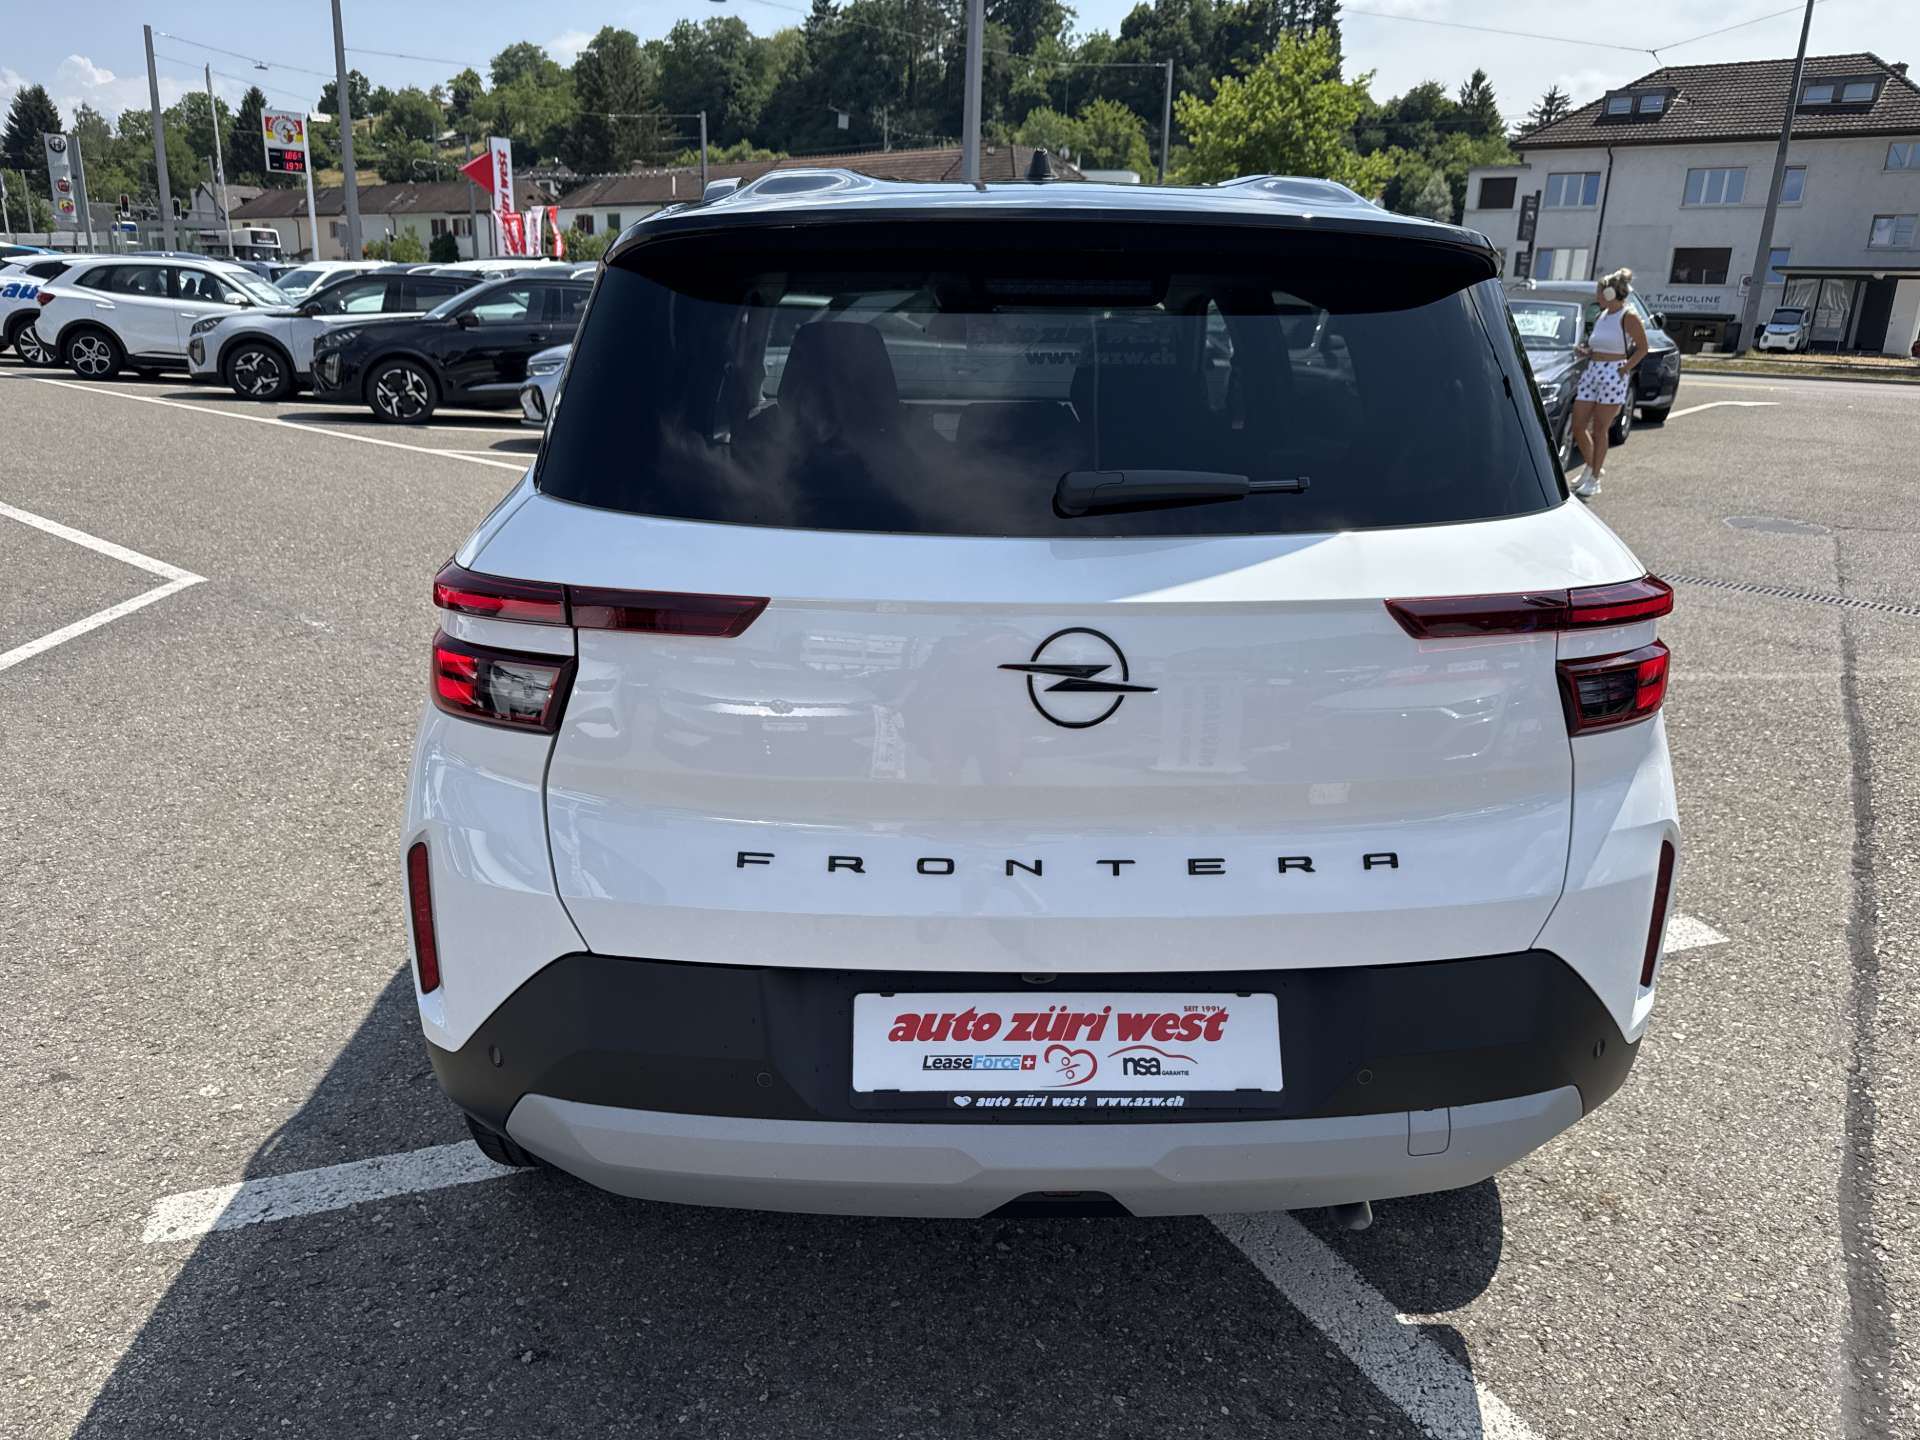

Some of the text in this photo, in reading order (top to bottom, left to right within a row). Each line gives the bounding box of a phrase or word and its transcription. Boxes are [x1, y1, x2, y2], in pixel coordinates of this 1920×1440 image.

[1656, 294, 1720, 304] TACHOLINE
[736, 851, 1399, 877] FRONTERA
[888, 1005, 1229, 1041] auto züri west
[922, 1055, 1020, 1070] LeaseForce
[1122, 1057, 1161, 1076] nsa
[976, 1095, 1185, 1107] auto züri west www.azw.ch
